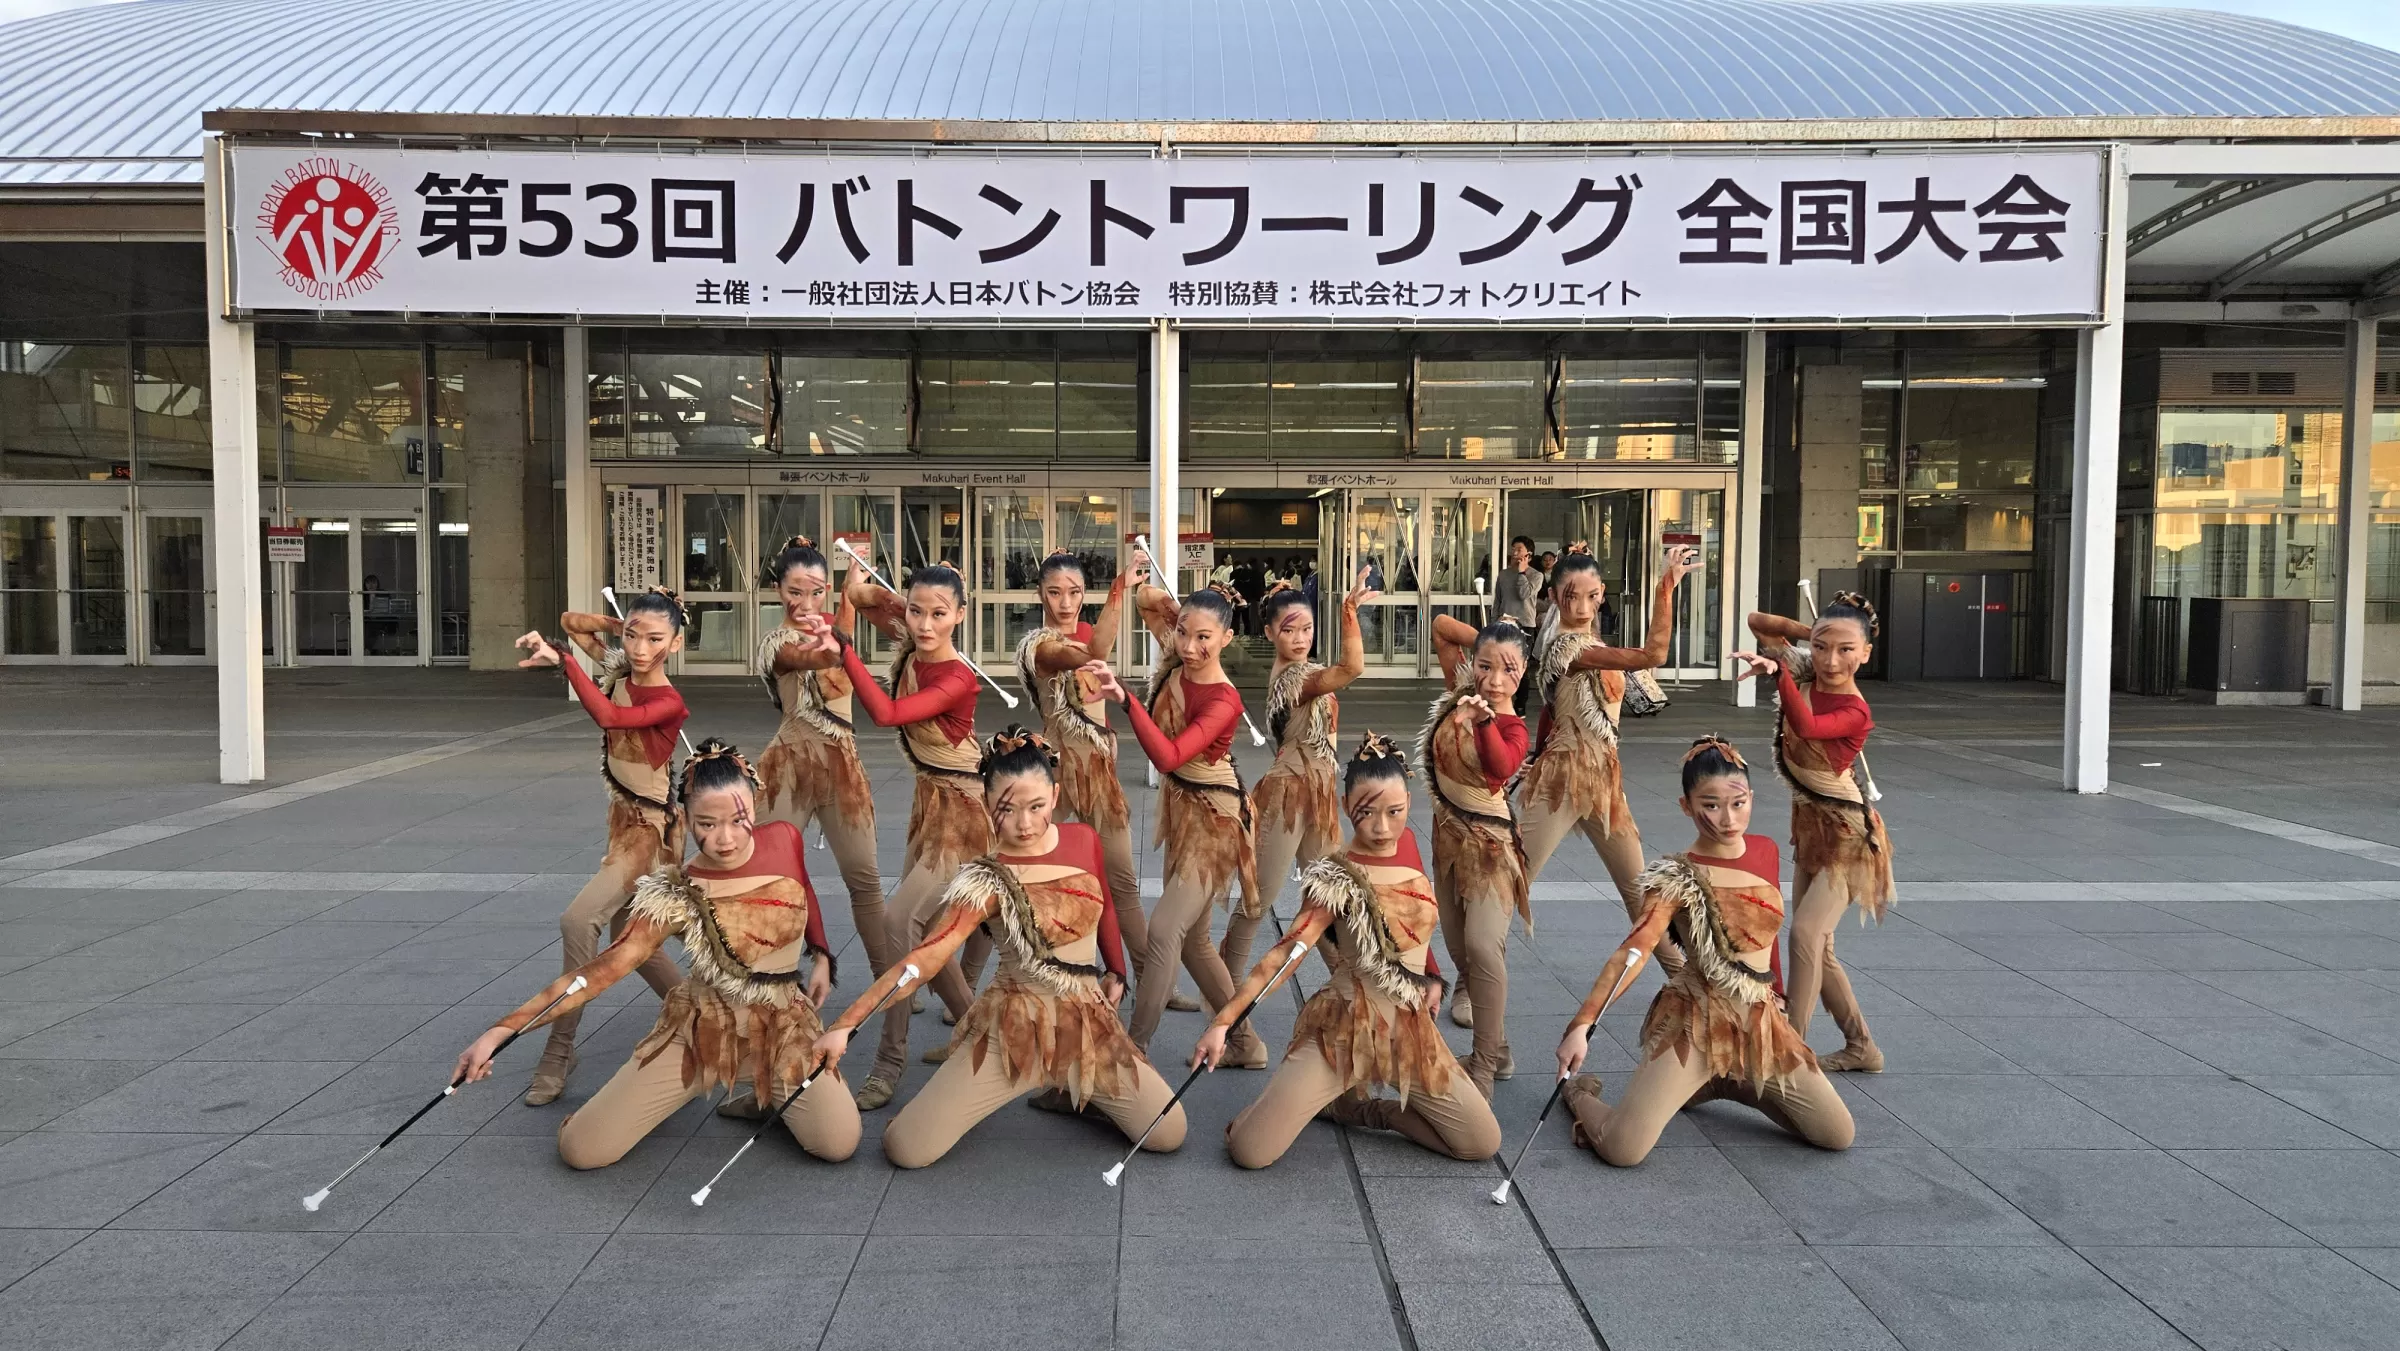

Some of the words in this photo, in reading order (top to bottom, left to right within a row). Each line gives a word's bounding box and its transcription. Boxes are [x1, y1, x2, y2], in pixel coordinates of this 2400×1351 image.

[256, 179, 290, 235] JAPAN
[284, 157, 340, 187] BATON
[347, 162, 400, 236] TWIRLING
[415, 172, 736, 264] 第53回
[776, 173, 1643, 267] バトントワーリング
[1677, 174, 2072, 266] 全国大会
[276, 265, 384, 301] ASSOCIATION
[696, 279, 1140, 307] 主催：一般社団法人日本バトン協会
[1169, 280, 1641, 308] 特別協賛：株式会社フォトクリエイト
[922, 473, 970, 484] Makuhari
[973, 473, 1003, 484] Event
[1006, 474, 1026, 484] Hall
[1449, 475, 1497, 485] Makuhari
[1500, 475, 1530, 485] Event
[1533, 475, 1554, 485] Hall
[645, 507, 655, 574] 特別警戒実施中
[1184, 544, 1206, 552] 指定席
[1189, 551, 1202, 559] 入口
